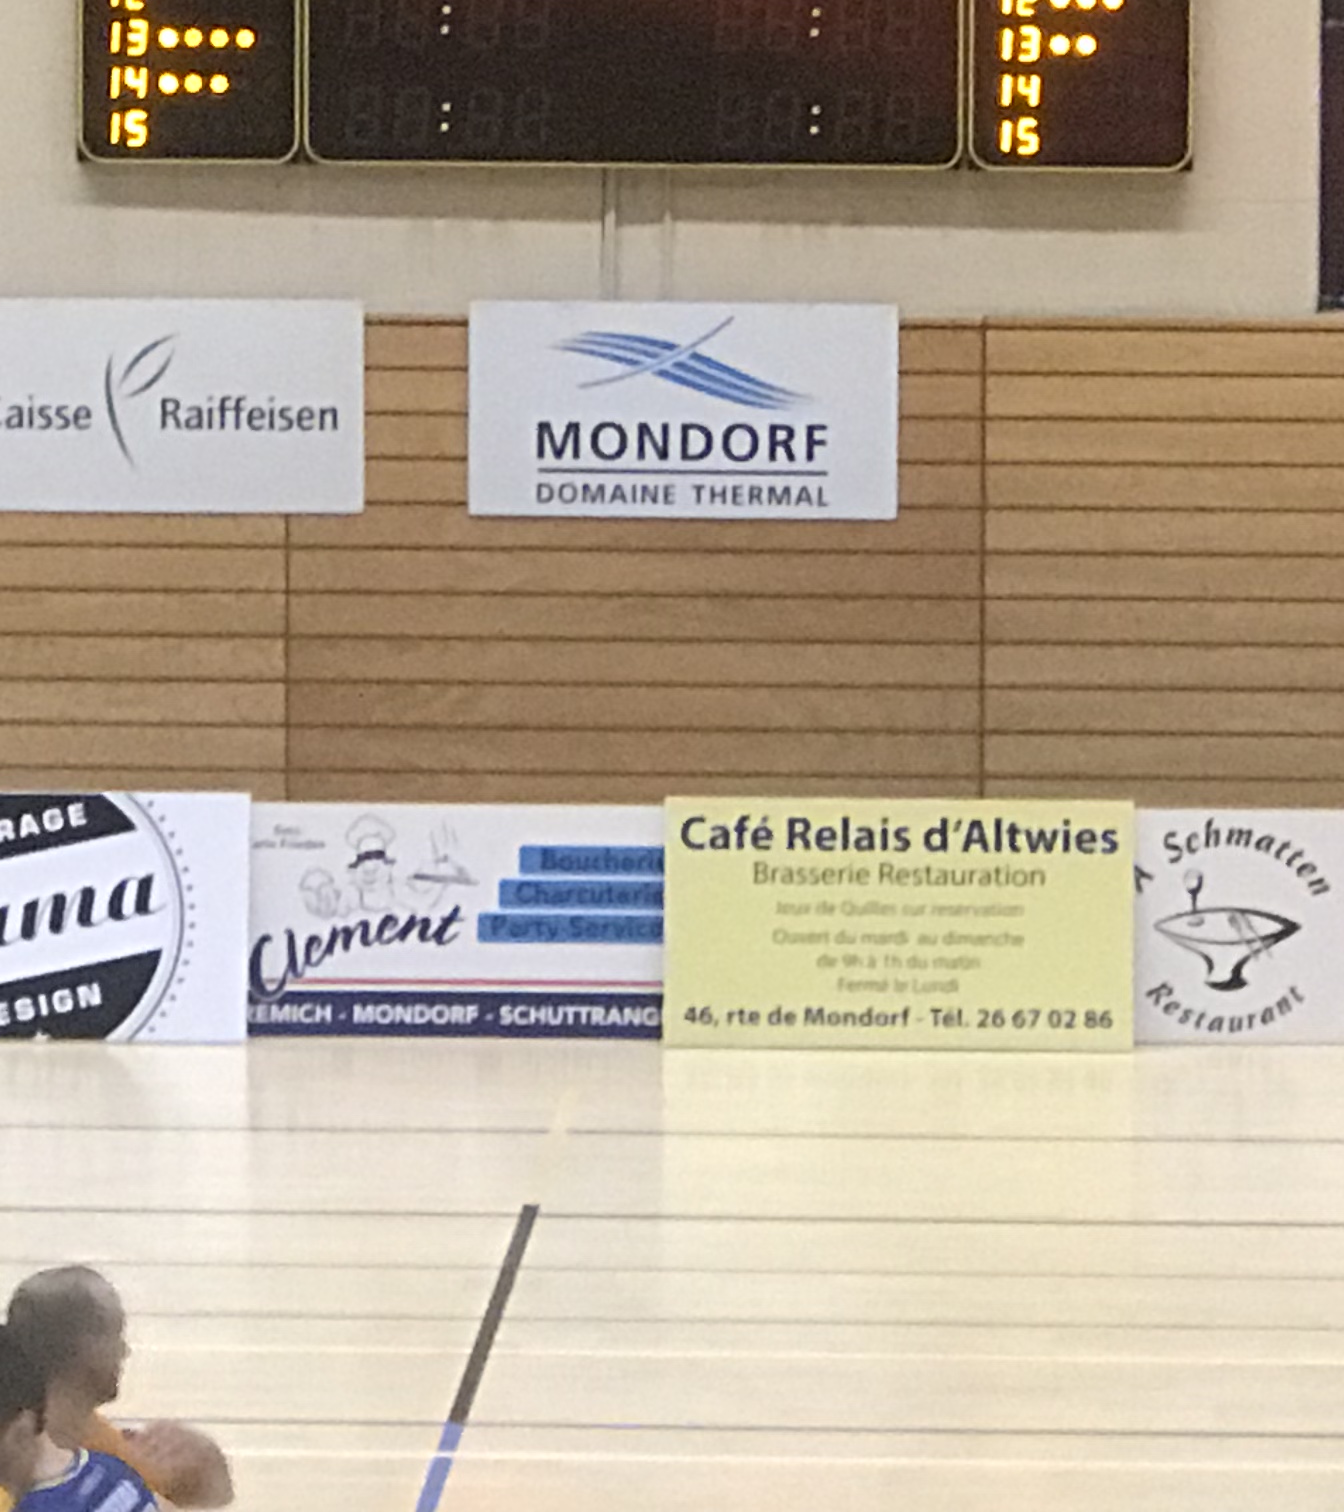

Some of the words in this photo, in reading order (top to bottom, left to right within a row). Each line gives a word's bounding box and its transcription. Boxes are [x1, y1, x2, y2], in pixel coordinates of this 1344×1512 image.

[110, 18, 149, 56] 13
[1000, 25, 1043, 62] 13
[110, 66, 148, 99] 14
[1000, 74, 1041, 107] 14
[111, 109, 147, 147] 15
[1000, 118, 1040, 155] 15
[160, 394, 339, 433] Raiffeisen
[536, 422, 829, 463] MONDORF
[536, 483, 677, 506] DOMAINE
[692, 484, 829, 507] THERMAL
[680, 815, 774, 851] Café
[786, 816, 911, 852] Relais
[753, 862, 871, 886] Brasserie
[879, 863, 1046, 888] Restauration
[1163, 817, 1331, 897] Schmatten
[352, 1004, 479, 1025] MONDORF
[684, 1006, 719, 1026] 46,
[726, 1008, 760, 1025] rte
[768, 1007, 796, 1026] de
[804, 1007, 910, 1028] Mondorf
[977, 1009, 1005, 1029] 26
[1011, 1009, 1040, 1029] 67
[1049, 1009, 1077, 1029] 02
[1084, 1010, 1113, 1030] 86
[1146, 982, 1307, 1034] Restaurant
